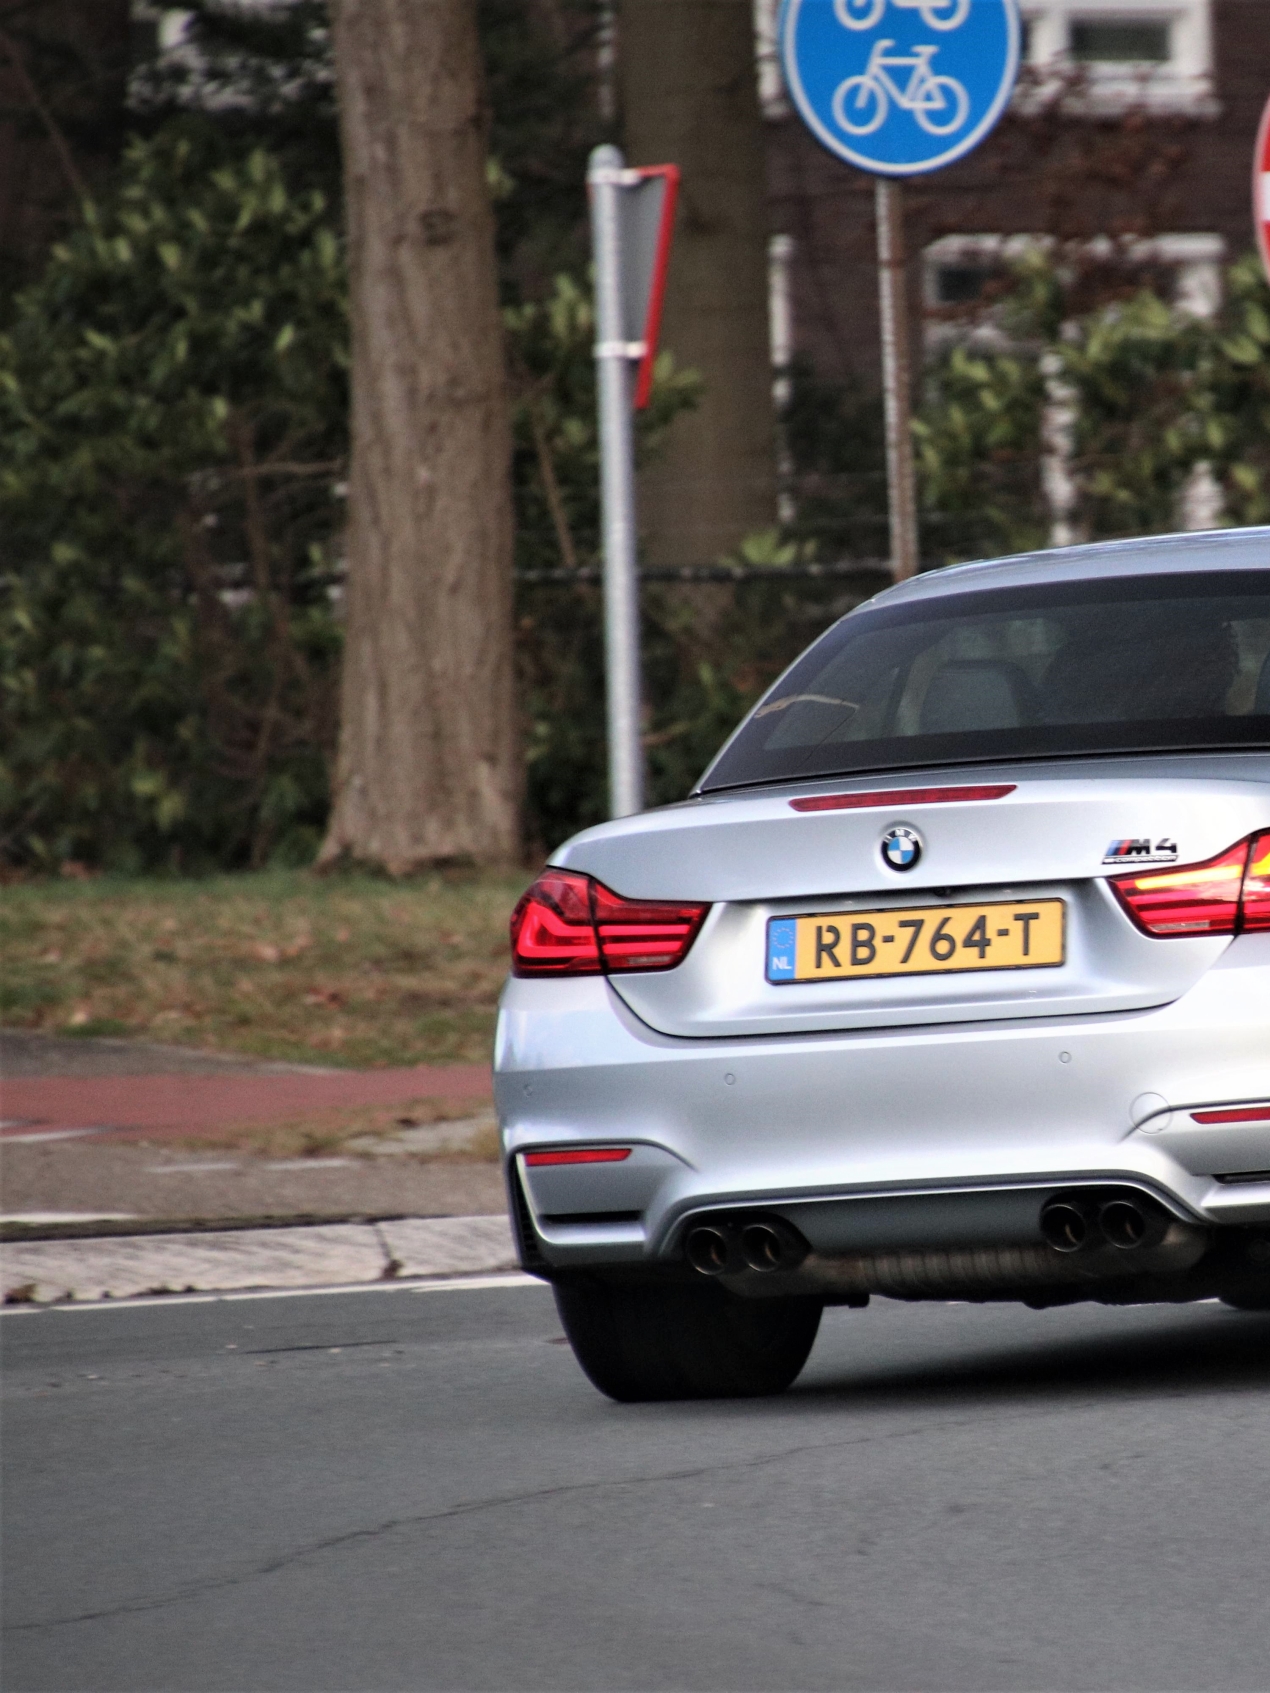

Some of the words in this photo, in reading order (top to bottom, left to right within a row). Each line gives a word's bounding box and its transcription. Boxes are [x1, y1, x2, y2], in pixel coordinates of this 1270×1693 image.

[1106, 838, 1178, 855] M4
[814, 912, 1040, 969] RB-764-T
[772, 956, 792, 970] NL
